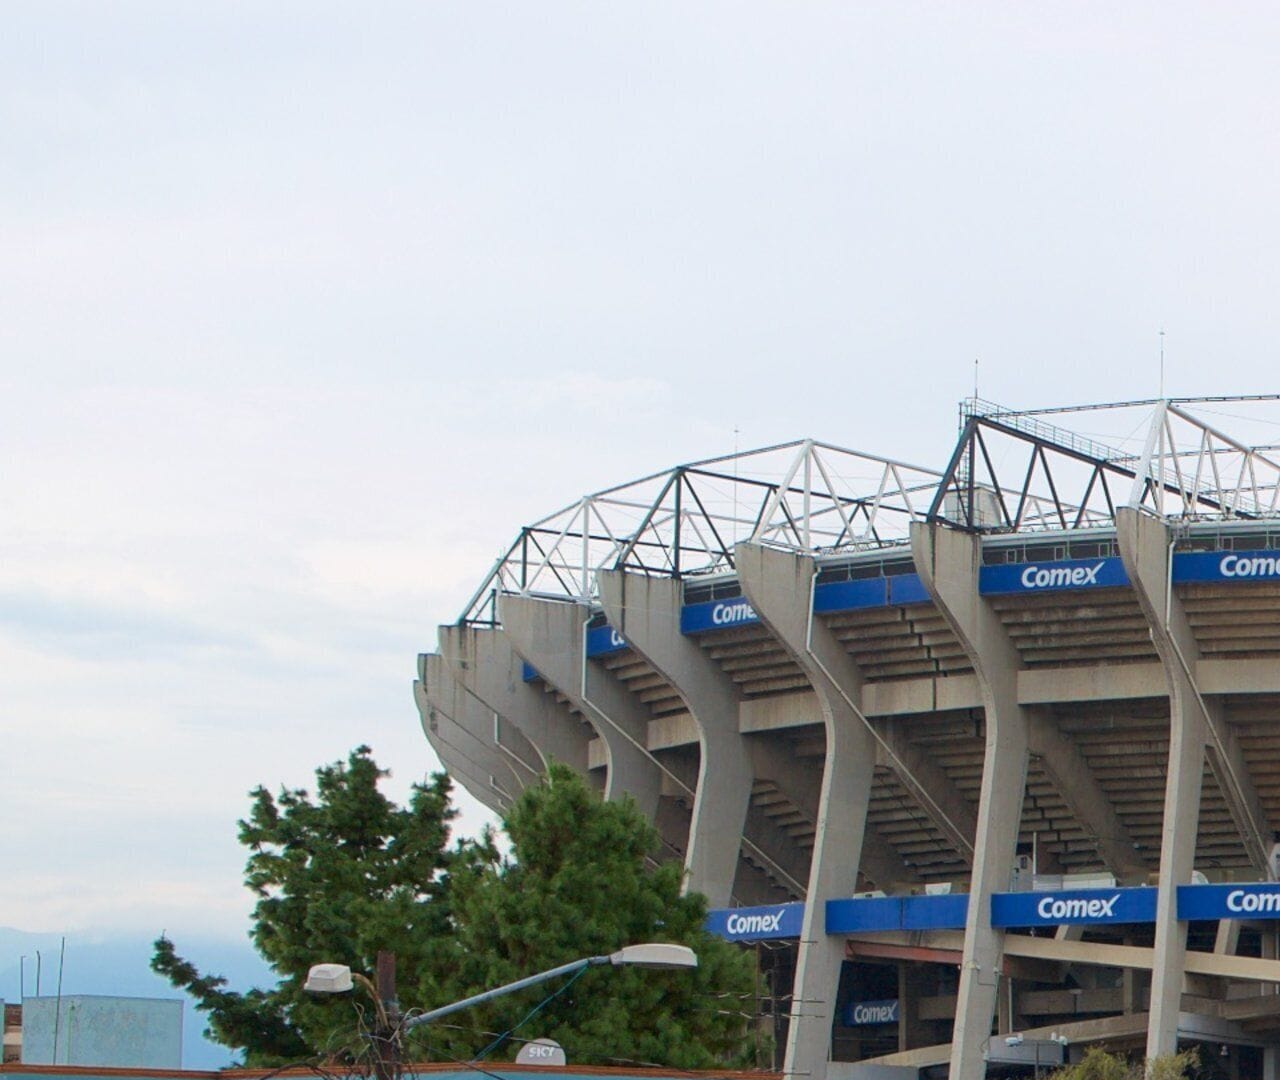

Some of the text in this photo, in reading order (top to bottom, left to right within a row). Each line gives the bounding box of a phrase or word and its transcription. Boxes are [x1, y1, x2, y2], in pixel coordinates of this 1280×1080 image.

[1021, 561, 1104, 588] Comex
[712, 603, 758, 625] Come
[1037, 894, 1121, 919] Comex
[726, 909, 788, 935] Comex
[853, 1003, 898, 1024] Comex
[529, 1047, 555, 1058] SKY
